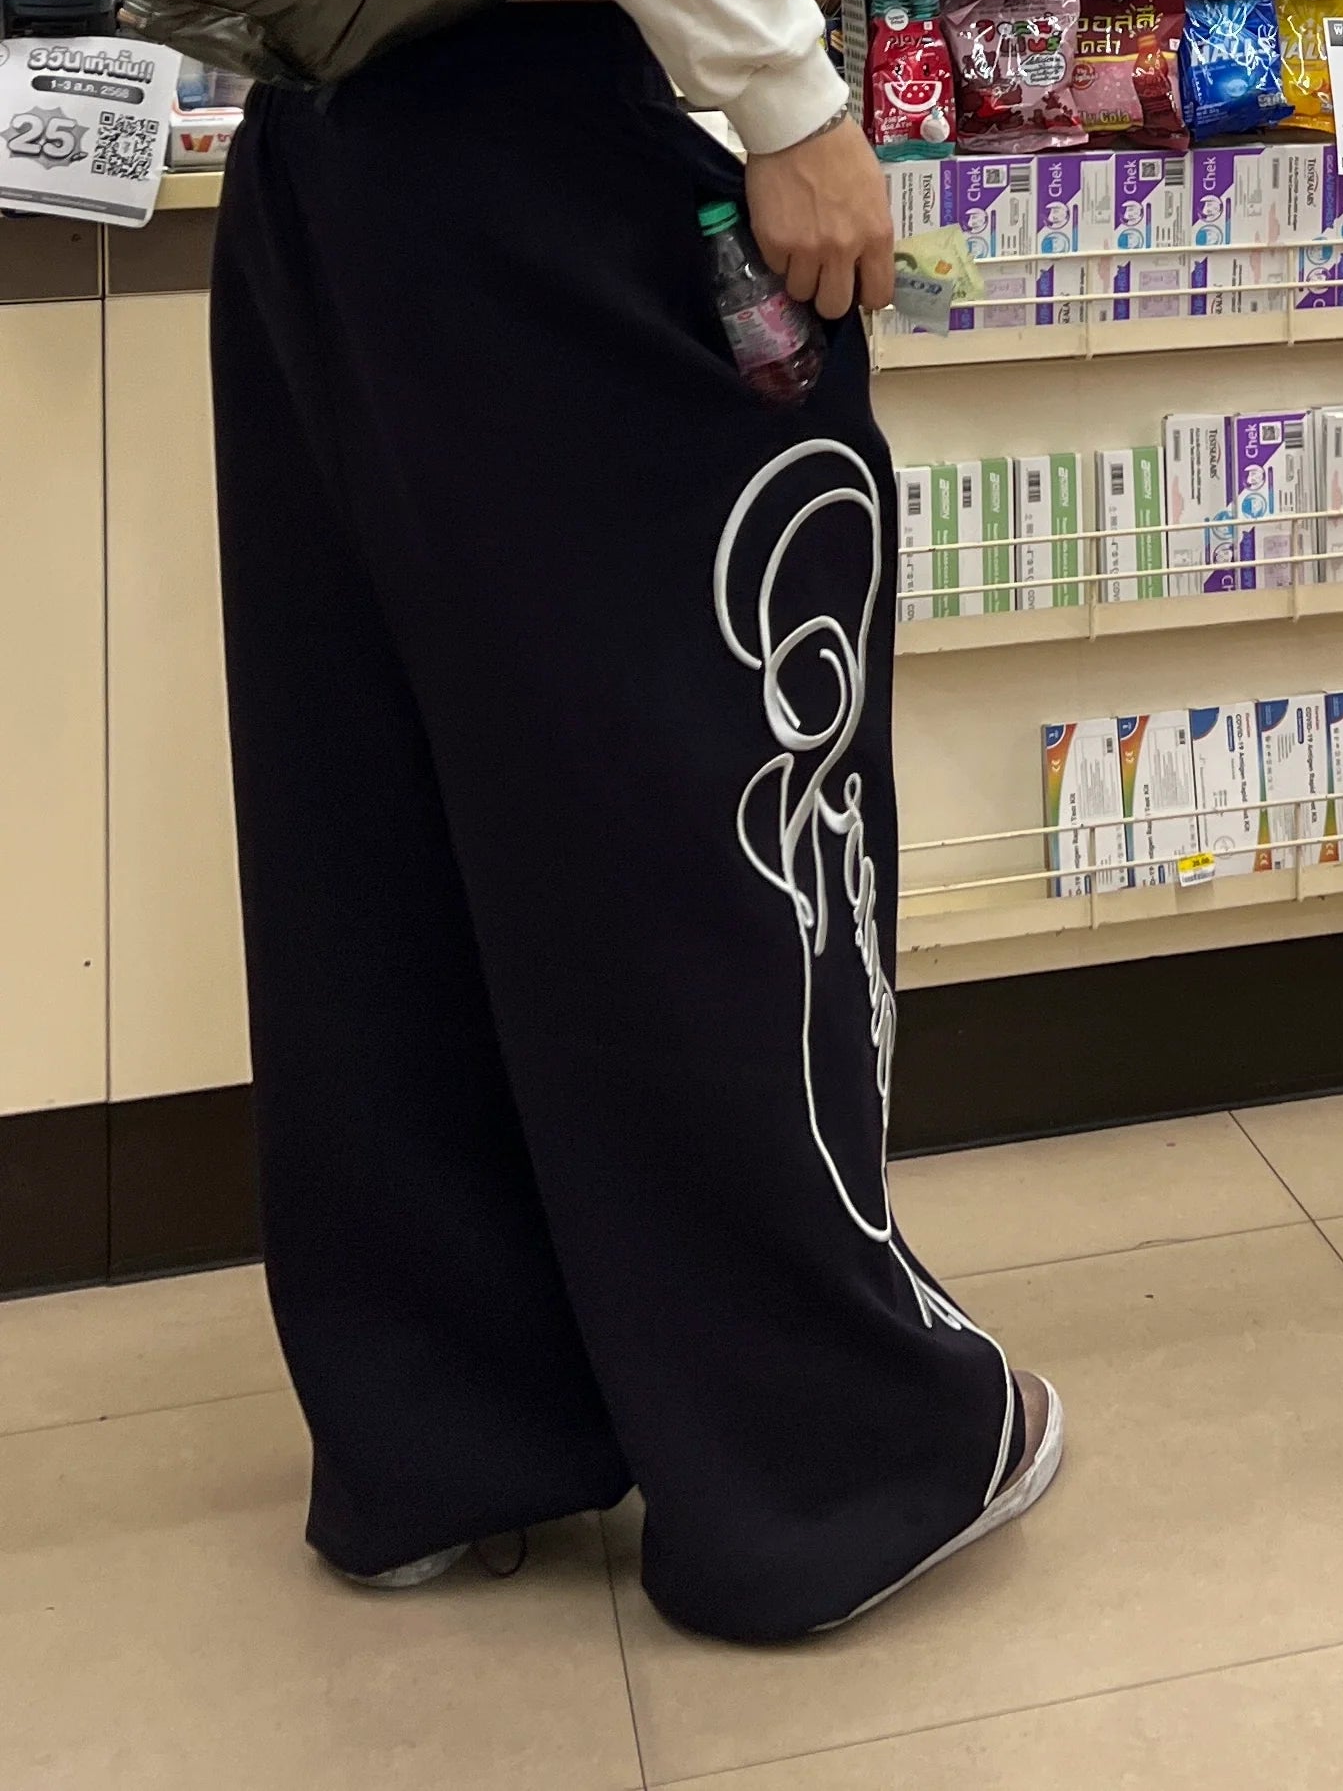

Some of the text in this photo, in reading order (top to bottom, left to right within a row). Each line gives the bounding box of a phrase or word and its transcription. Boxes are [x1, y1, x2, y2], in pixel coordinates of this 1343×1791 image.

[51, 80, 71, 90] 1-3
[967, 167, 981, 201] Chek
[1048, 162, 1062, 198] Chek
[1123, 160, 1137, 195] Chek
[1203, 156, 1217, 191] Chek
[1246, 424, 1258, 458] Chek
[1235, 713, 1245, 752] COVID-19
[1305, 706, 1314, 744] COVID-19
[1238, 753, 1246, 780] Antigen
